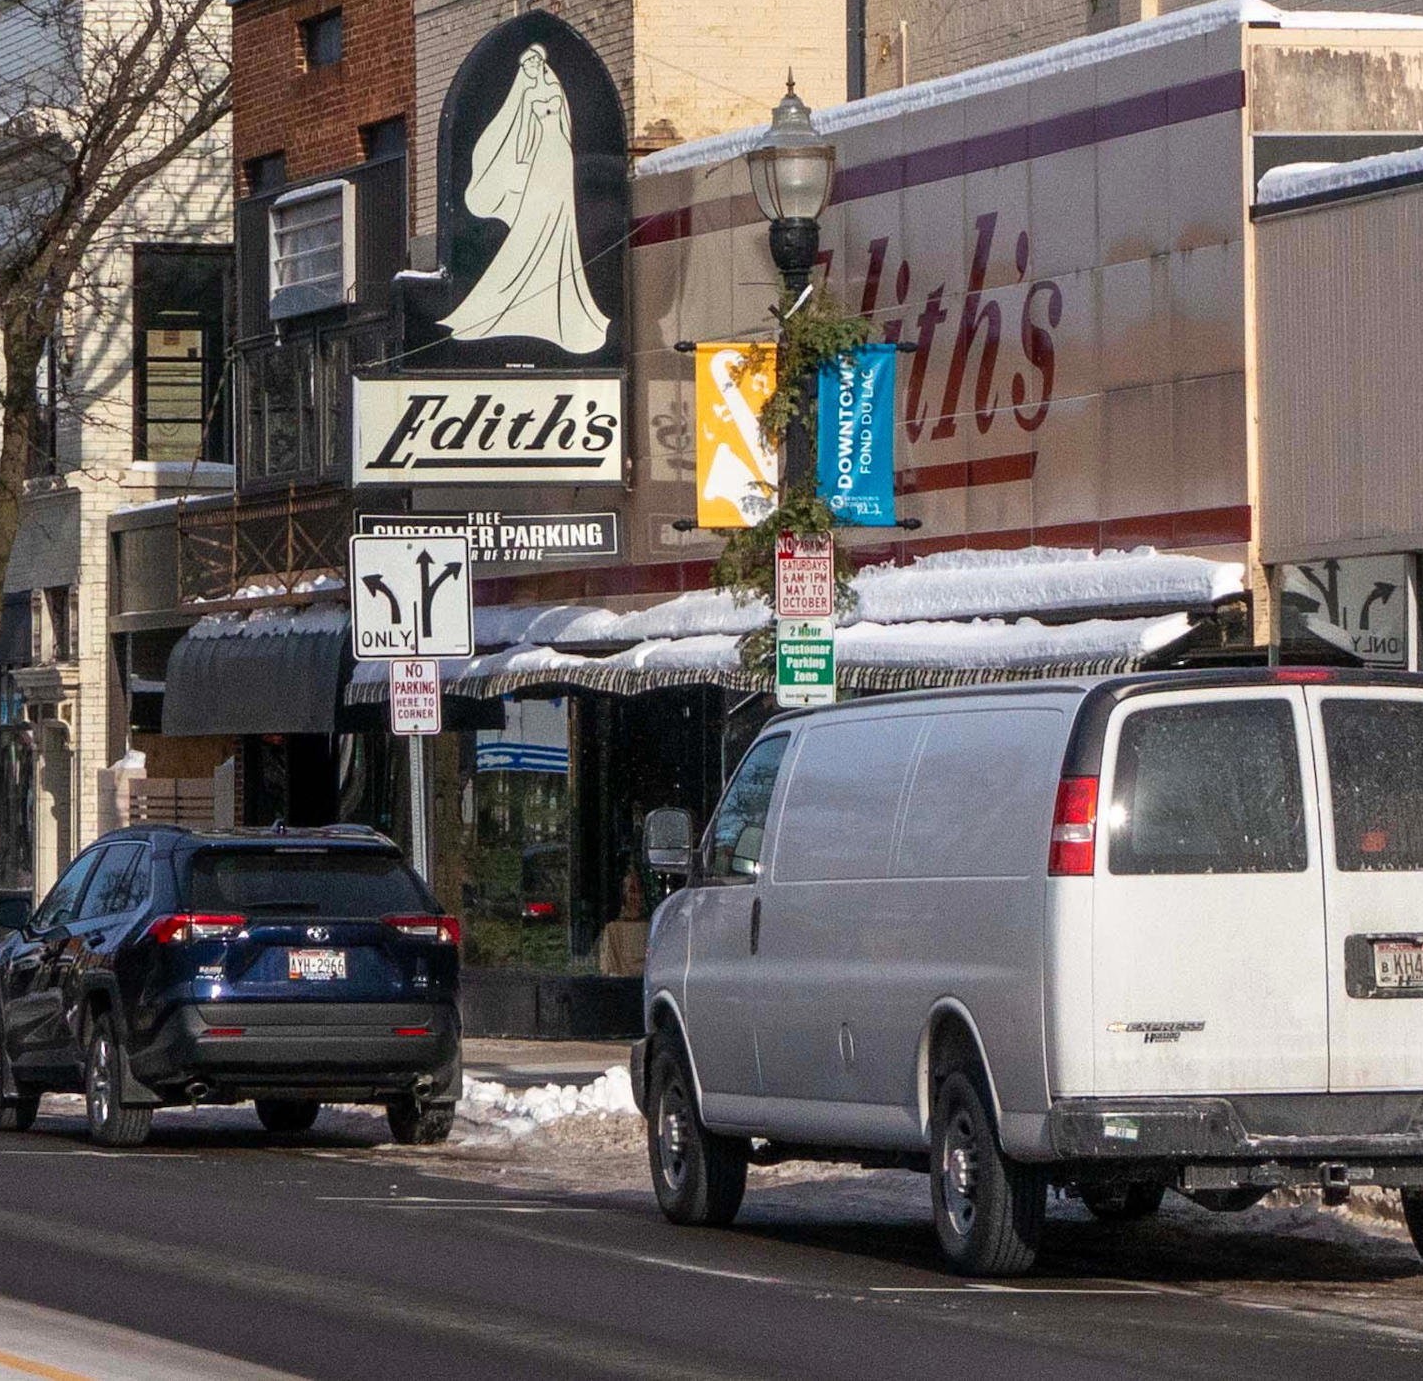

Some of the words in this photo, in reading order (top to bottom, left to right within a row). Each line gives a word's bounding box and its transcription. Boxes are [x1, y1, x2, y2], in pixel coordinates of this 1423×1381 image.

[861, 369, 875, 398] LAC
[861, 403, 873, 425] DU
[364, 394, 618, 470] Edith's
[860, 429, 873, 475] FOND
[467, 512, 502, 525] FREE
[500, 524, 603, 547] PARKING
[777, 537, 794, 554] NO
[484, 549, 498, 560] OF
[504, 548, 545, 560] STORE
[782, 560, 828, 571] SATURDAYS
[782, 573, 788, 584] 6
[786, 585, 807, 596] MAY
[812, 585, 824, 596] TO
[782, 597, 827, 609] OCTOBER
[789, 625, 796, 637] 2
[798, 626, 822, 637] Hour
[362, 630, 412, 648] ONLY
[780, 643, 831, 655] Customer
[786, 656, 826, 670] Parking
[405, 664, 423, 678] NO
[793, 670, 819, 682] Zone
[395, 681, 435, 695] PARKING
[397, 698, 418, 707] HERE
[423, 698, 435, 707] TO
[397, 709, 435, 719] CORNER
[291, 957, 344, 973] AYH-2966
[1381, 962, 1389, 974] B
